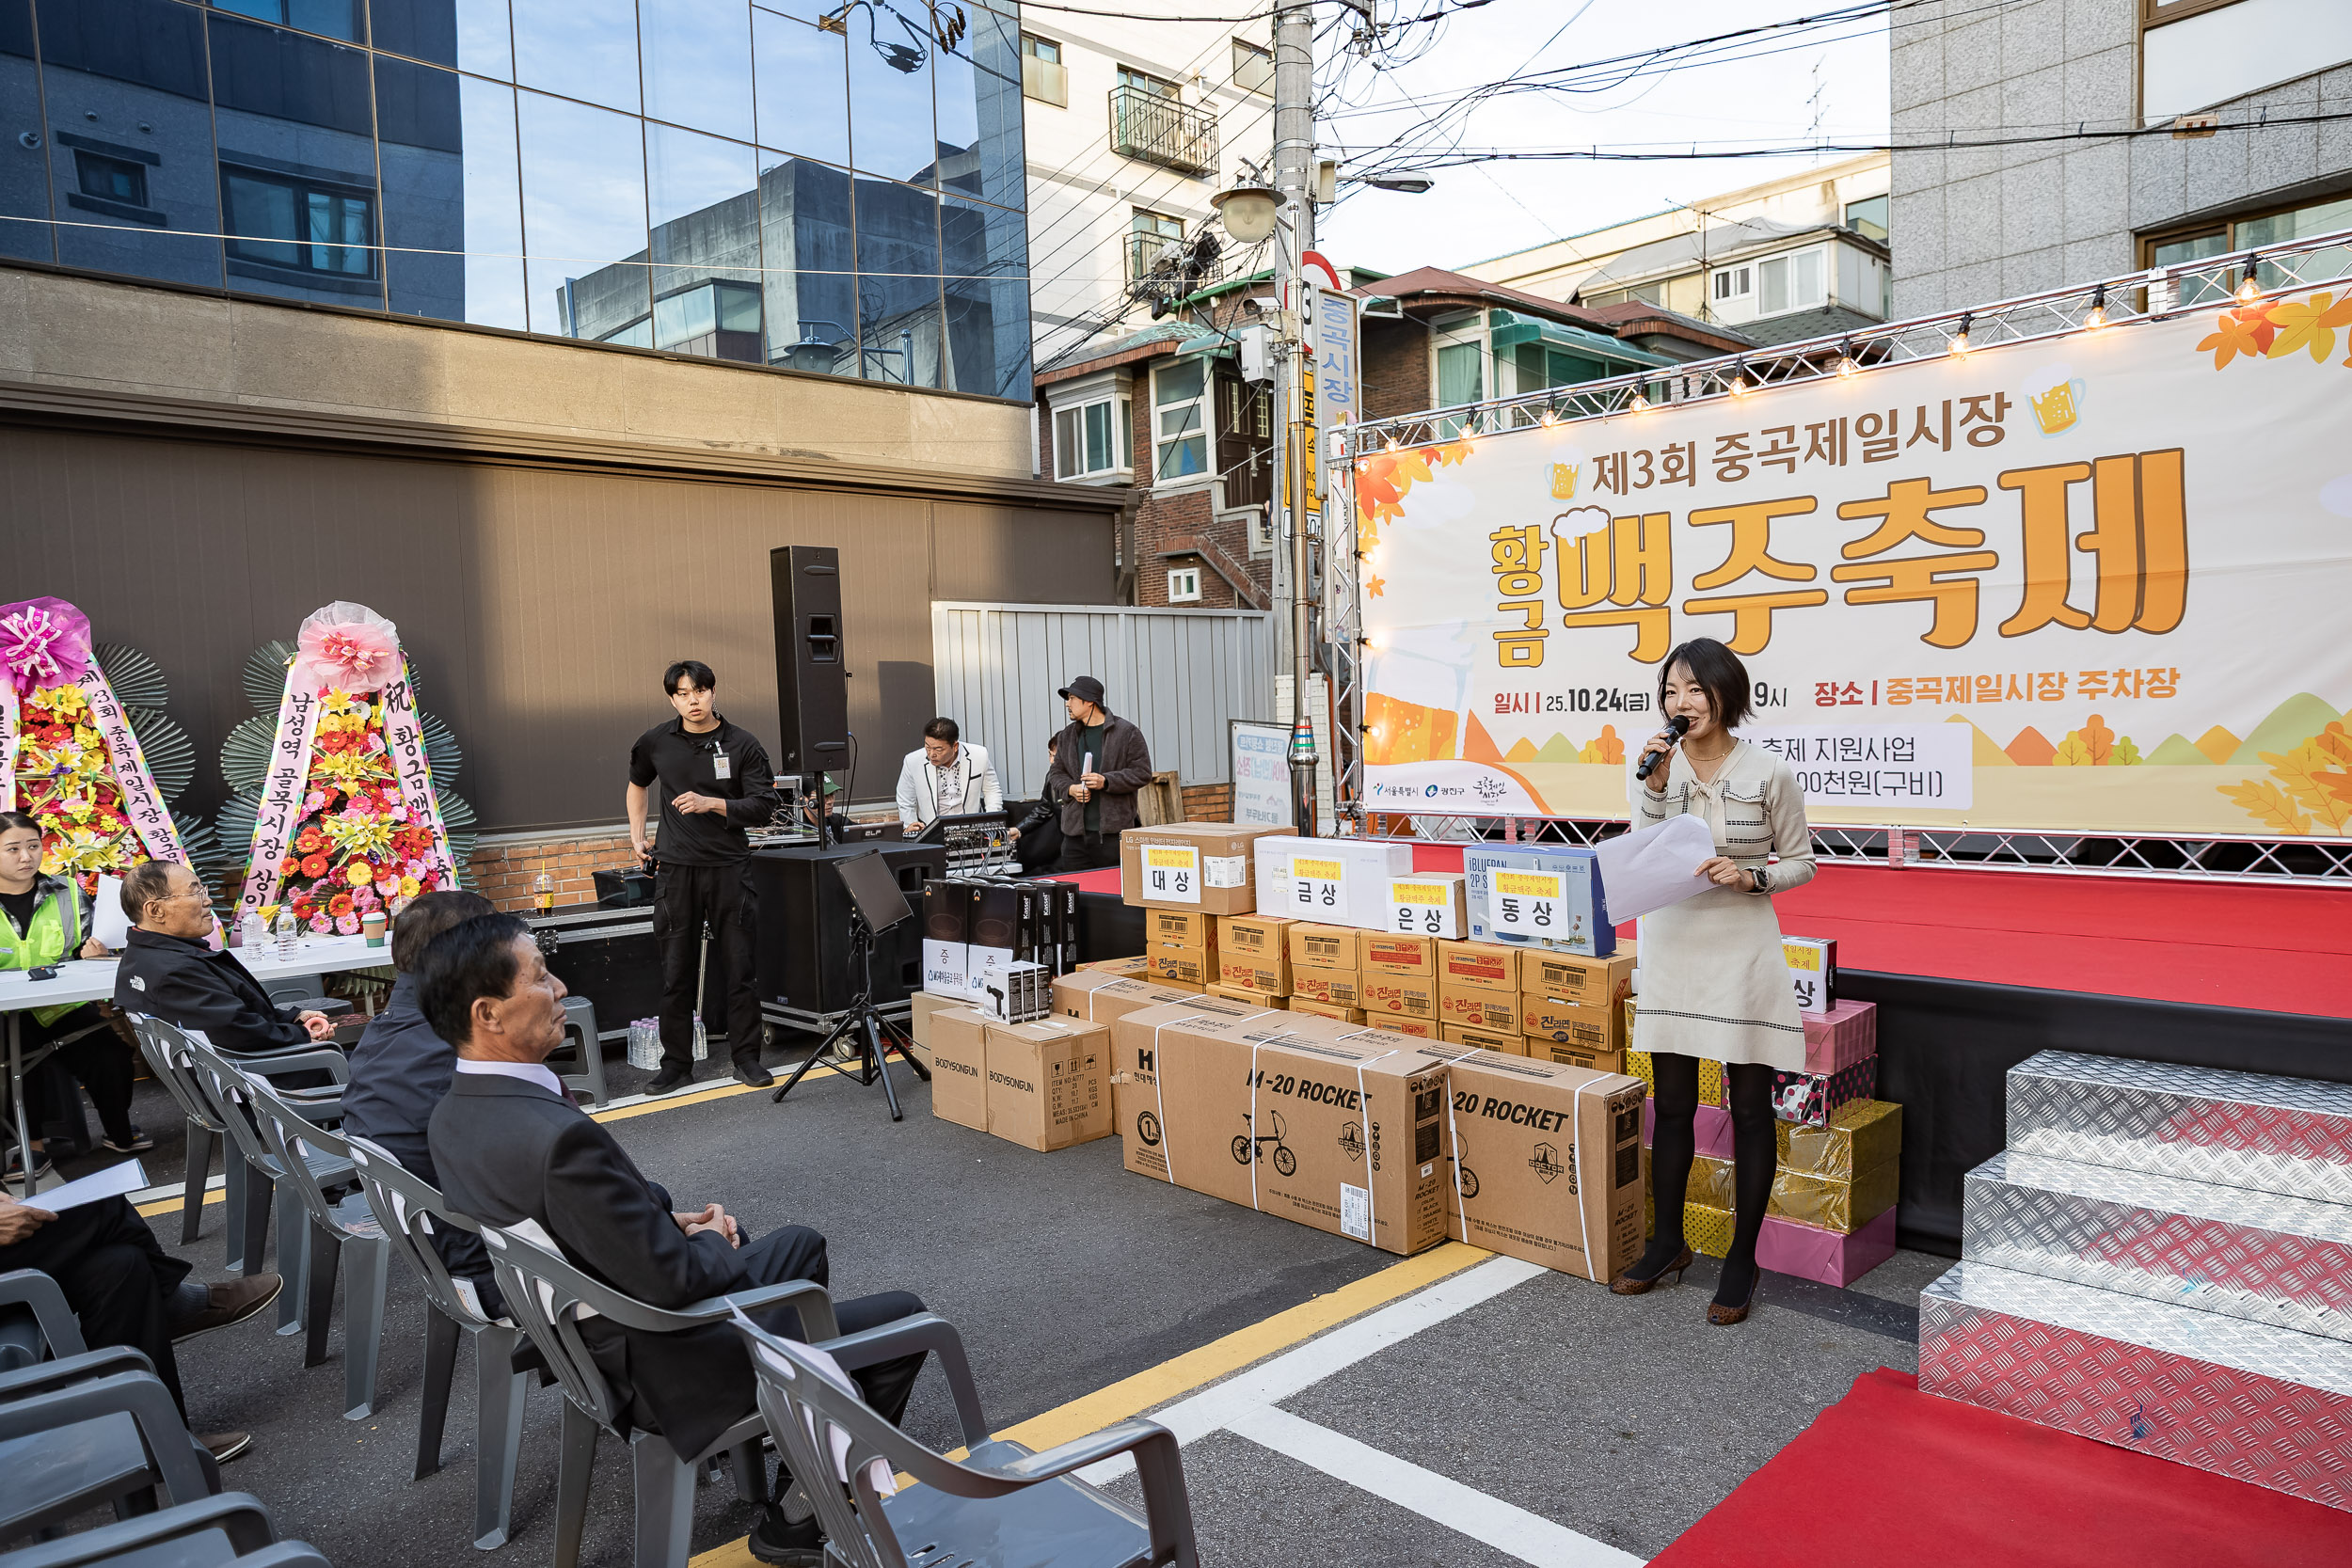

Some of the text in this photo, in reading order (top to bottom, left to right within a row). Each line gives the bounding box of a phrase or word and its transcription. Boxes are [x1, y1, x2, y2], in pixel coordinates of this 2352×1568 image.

[1321, 298, 1353, 404] 중곡시장
[1593, 391, 2012, 495] 제3회 중곡제일시장
[1550, 448, 2189, 664] 맥주축제
[1488, 524, 1549, 669] 황금
[77, 669, 119, 720] 제3회
[384, 680, 413, 714] 祝
[1815, 667, 2182, 707] 장소 중곡제일시장 주차장
[1494, 692, 1530, 714] 일시
[1546, 688, 1650, 713] 25.10.24(금)
[281, 692, 315, 760] 남성역
[1816, 737, 1916, 763] 지원사업
[108, 725, 160, 825] 중곡제일시장
[1384, 785, 1465, 797] 서울특별시 광진구
[262, 768, 299, 862] 골목시장
[1470, 874, 1481, 888] 2P
[1501, 872, 1554, 883] 제3회 중곡제일시장
[1399, 895, 1441, 905] 황금맥주 축제
[1502, 883, 1553, 897] 황금맥주 축제
[1023, 895, 1031, 920] Kassel
[1790, 957, 1810, 970] 축제
[1306, 979, 1328, 993] 진라면
[1376, 987, 1401, 1000] 진라면
[1794, 979, 1816, 1007] 상
[1455, 999, 1482, 1013] 진라면
[1540, 1016, 1570, 1030] 진라면
[935, 1056, 978, 1078] BODYSONGUN
[989, 1070, 1034, 1093] BODYSONGUN
[1297, 1079, 1374, 1115] ROCKET
[1055, 1117, 1069, 1126] MADE
[1074, 1111, 1089, 1120] CHINA
[1447, 1091, 1569, 1133] -20 ROCKET
[1529, 1159, 1564, 1174] DOCTOR
[1415, 1185, 1439, 1200] ROCKET
[1423, 1202, 1438, 1212] BLACK
